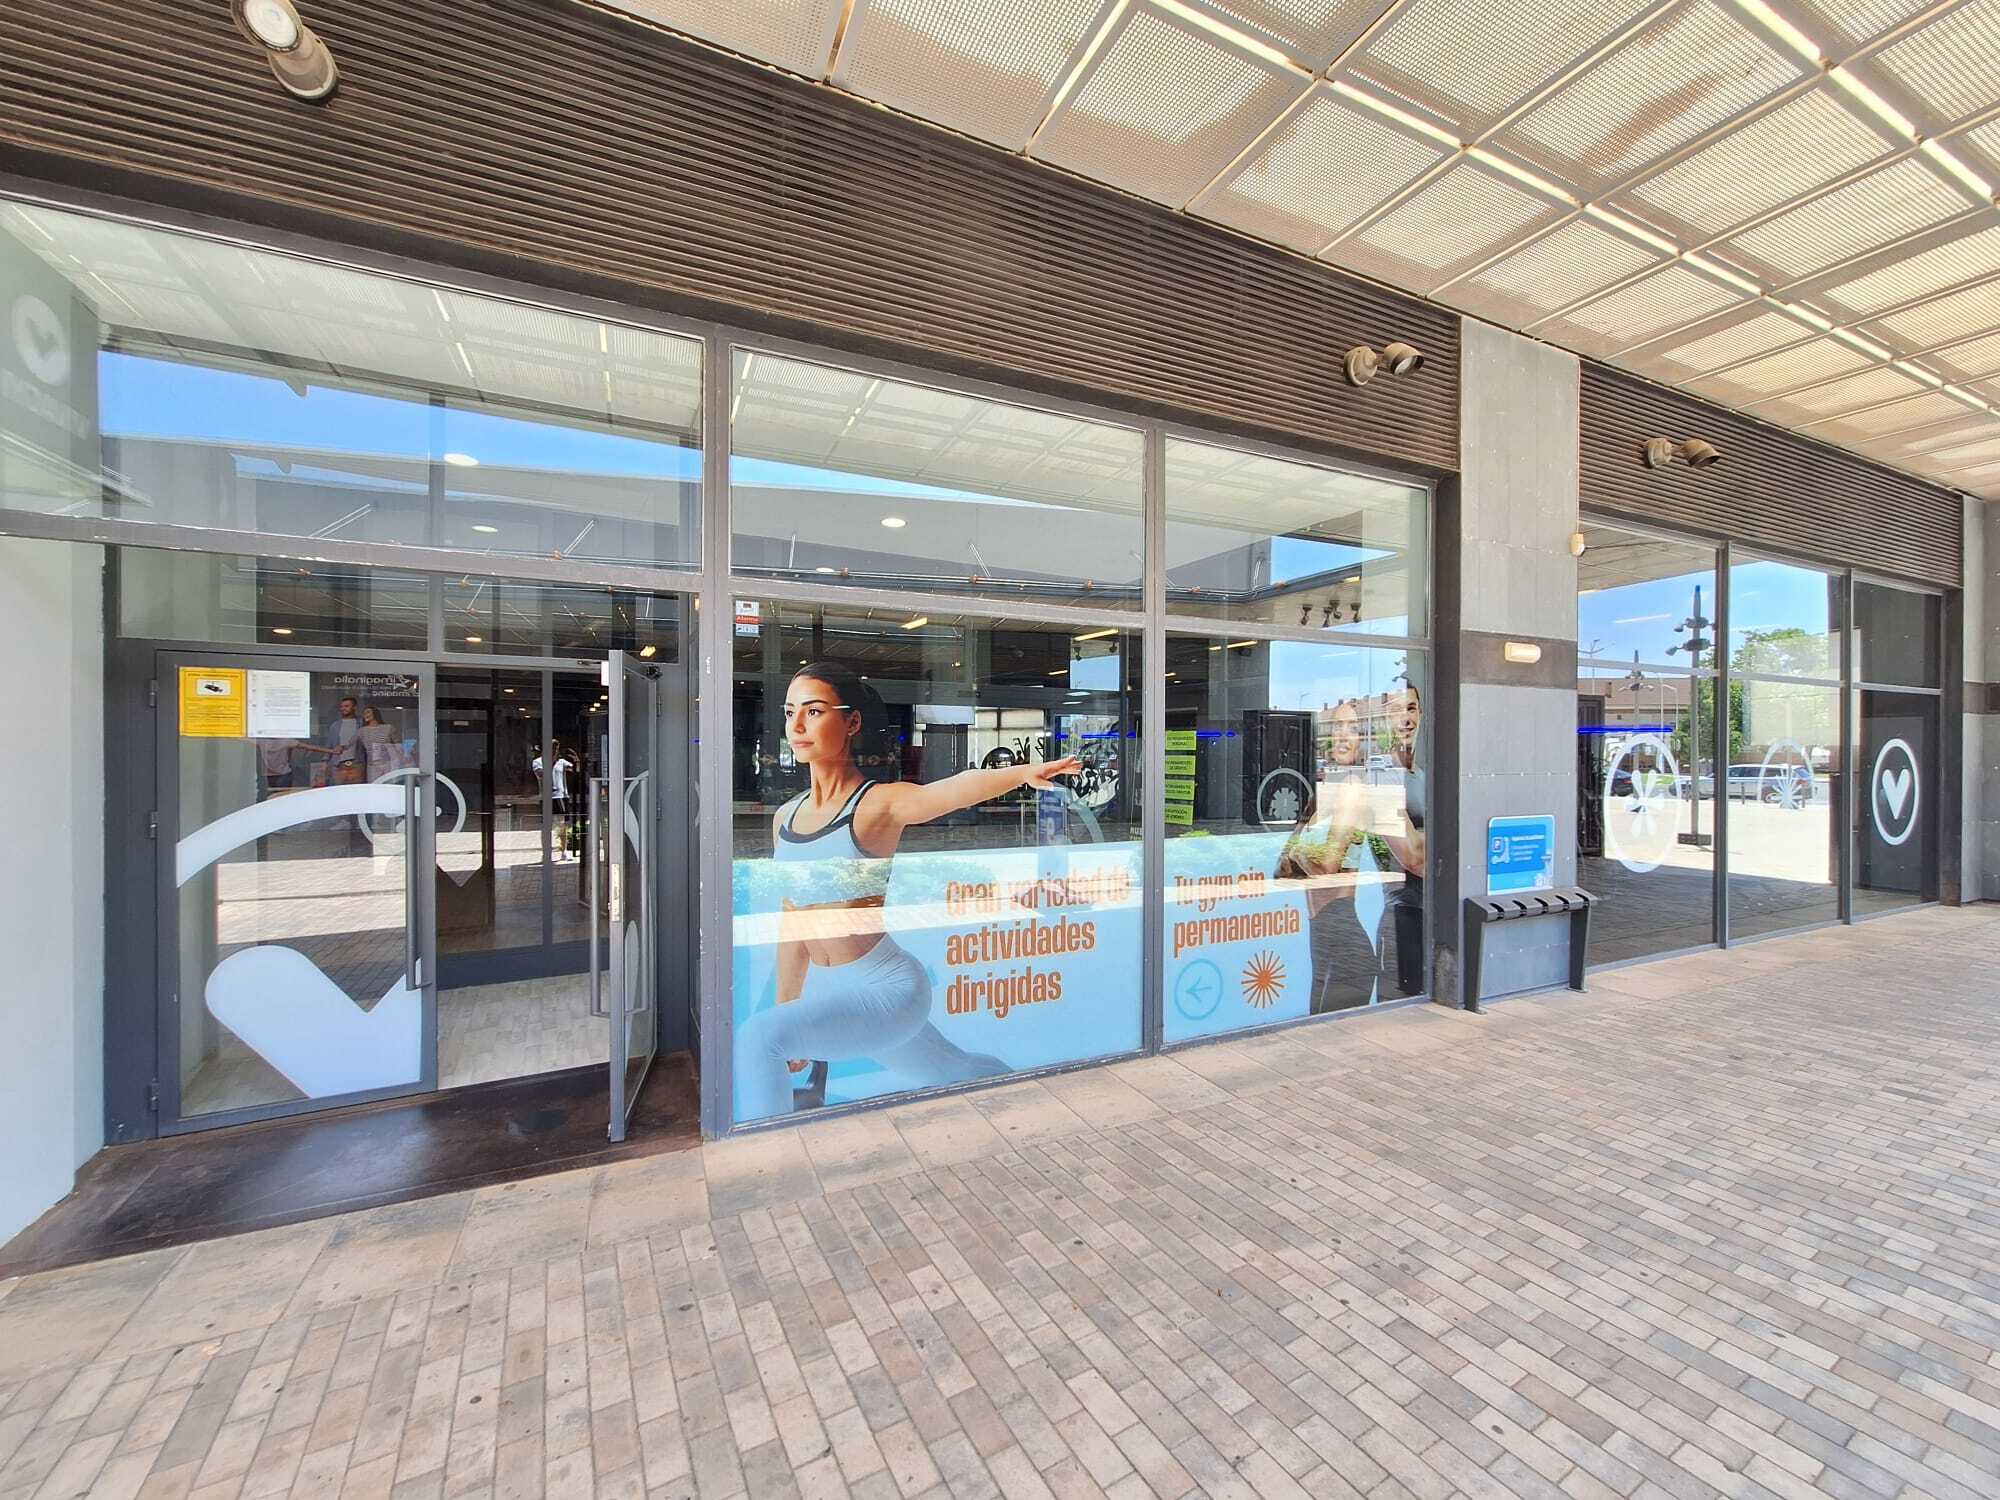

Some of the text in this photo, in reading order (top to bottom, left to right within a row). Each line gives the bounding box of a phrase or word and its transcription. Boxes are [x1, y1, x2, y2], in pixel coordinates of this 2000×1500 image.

[946, 880, 999, 916] Gran
[1008, 866, 1102, 911] variedad
[1174, 866, 1265, 912] Tu gym sin
[946, 915, 1095, 965] actividades
[1173, 903, 1300, 958] permanencia
[946, 966, 1062, 1018] dirigidas
